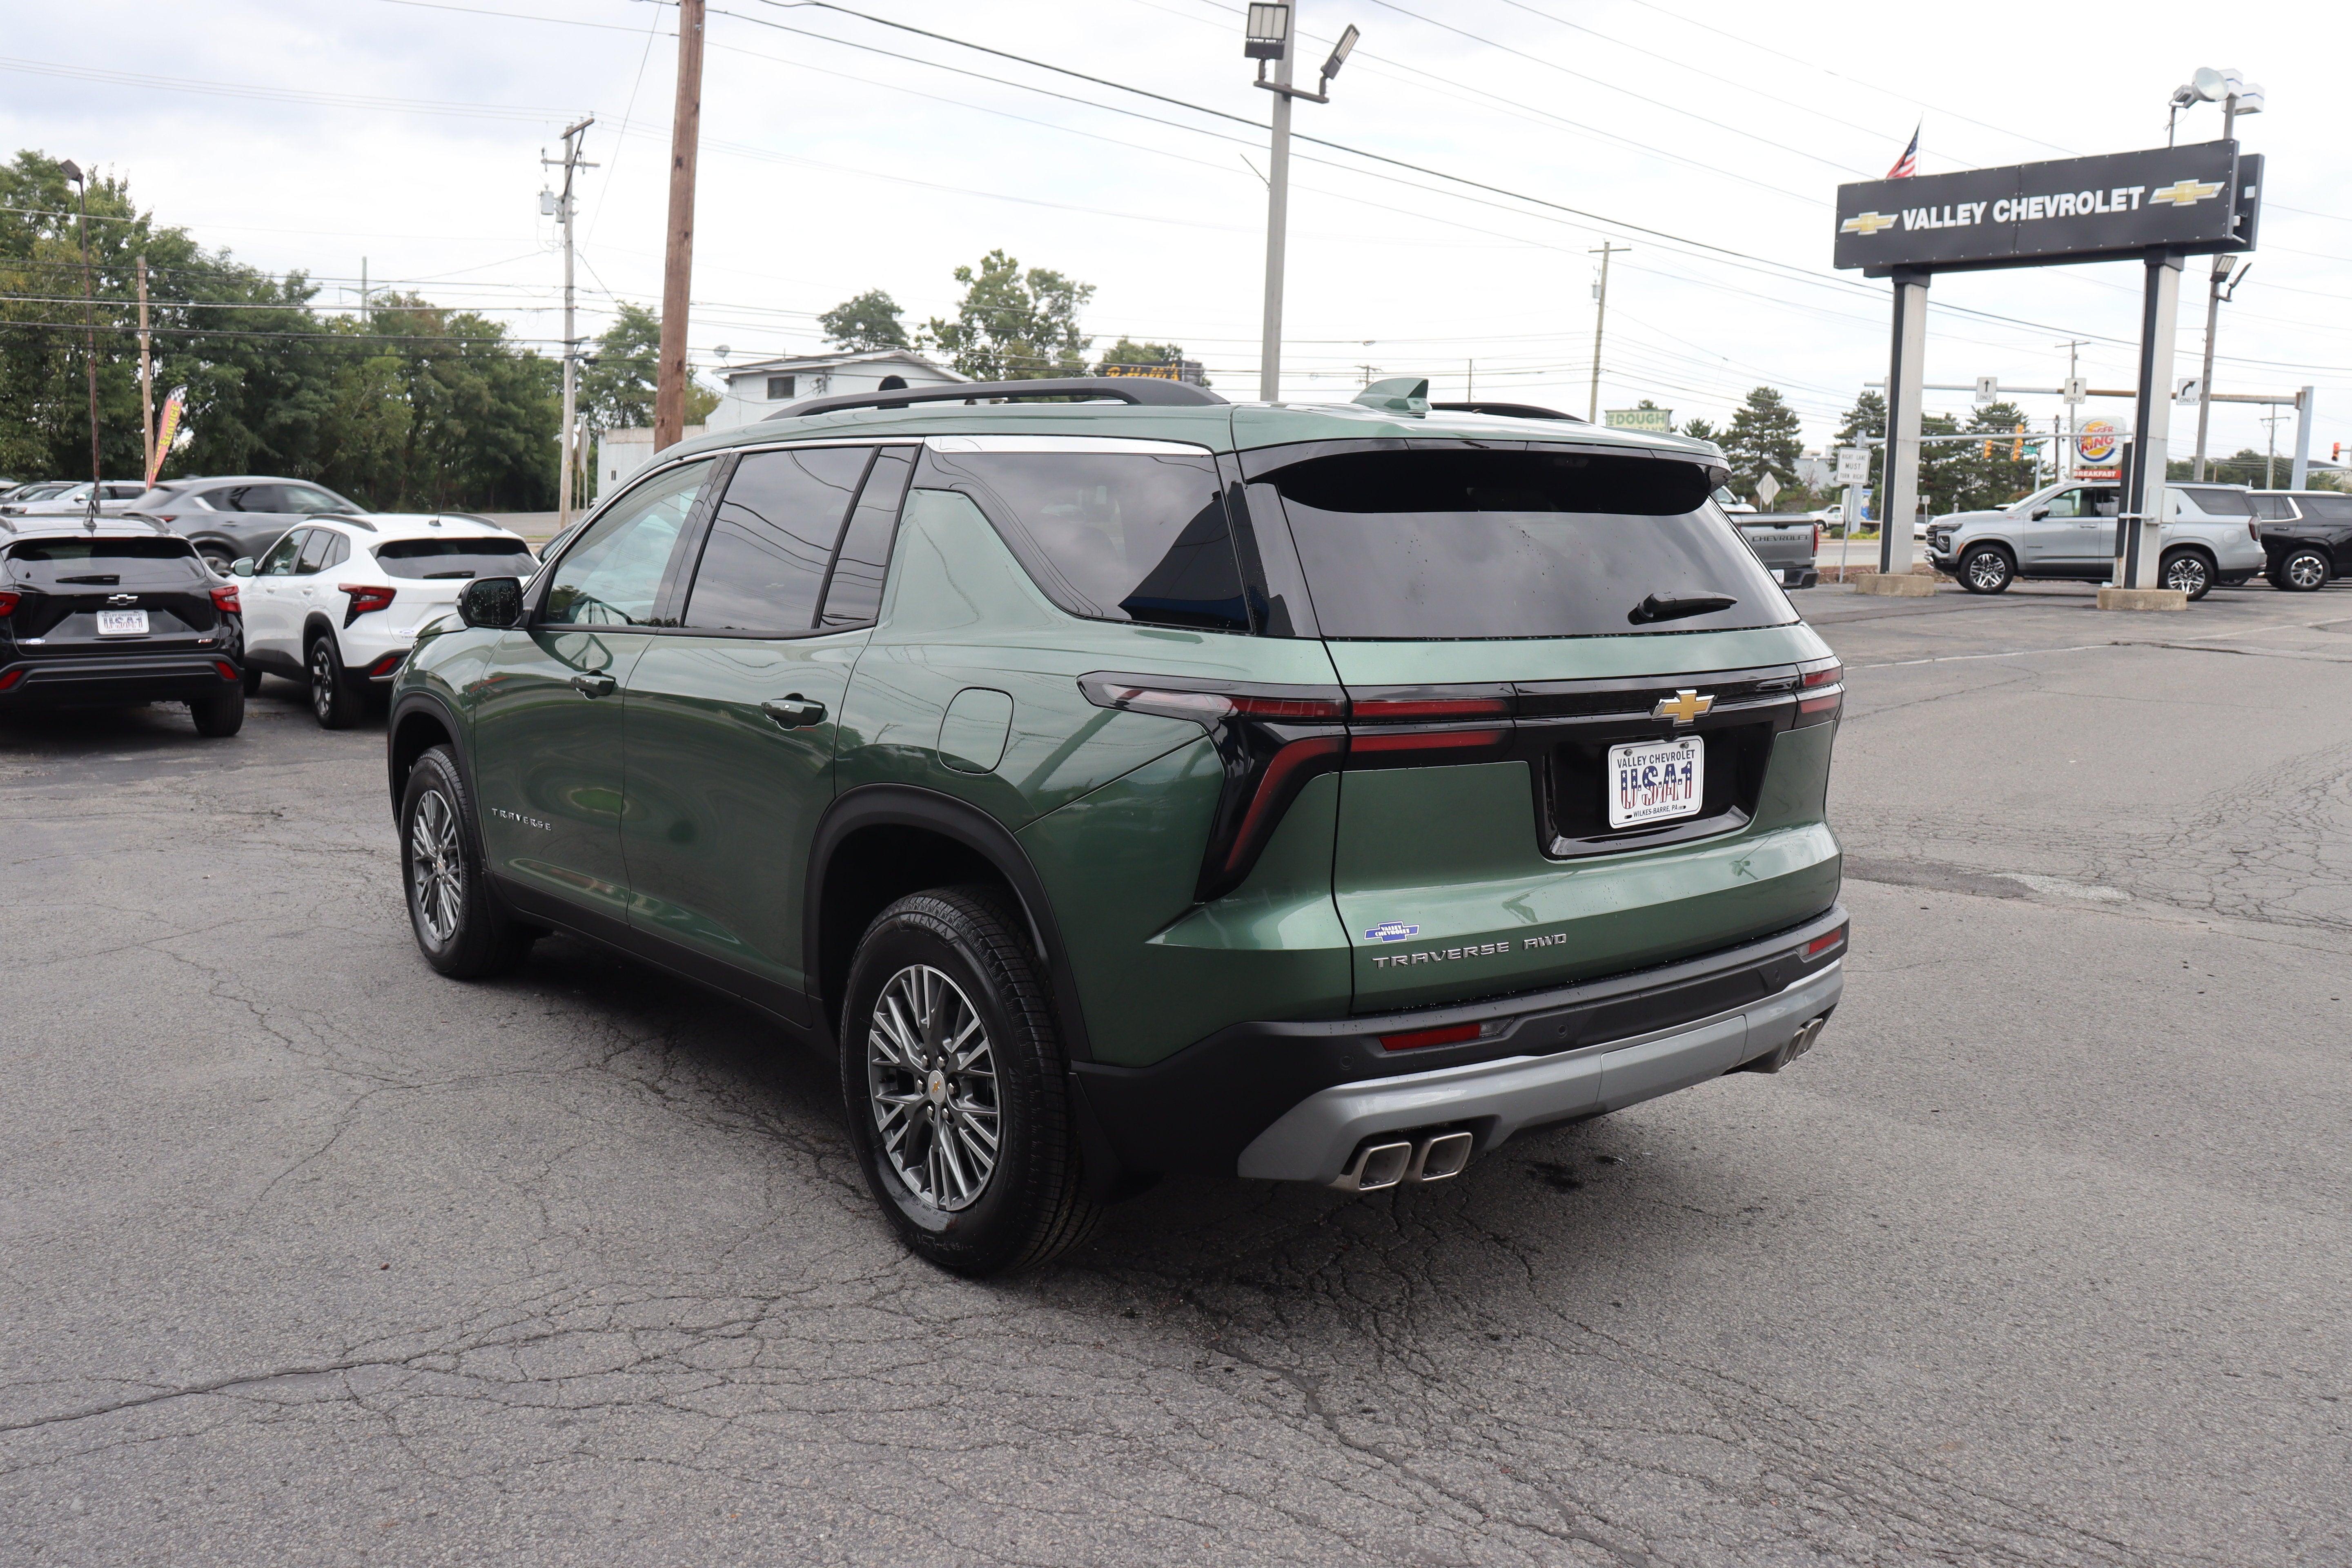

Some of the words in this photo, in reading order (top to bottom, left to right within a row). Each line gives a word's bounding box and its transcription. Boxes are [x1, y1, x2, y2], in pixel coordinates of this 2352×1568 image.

[1902, 201, 1987, 231] VALLEY
[1992, 186, 2145, 223] CHEVROLET
[159, 403, 180, 447] SERVICE
[1616, 413, 1665, 425] DOUGH
[1617, 755, 1647, 768] VALLEY
[1649, 749, 1695, 764] CHEVROLET
[492, 808, 552, 831] TRAVERSE
[1633, 805, 1670, 818] WILKES-BARRE,
[904, 913, 948, 938] ALENZA
[1374, 928, 1410, 937] CHEVROLET
[1372, 941, 1510, 969] TRAVERSE
[1522, 933, 1567, 951] AWD
